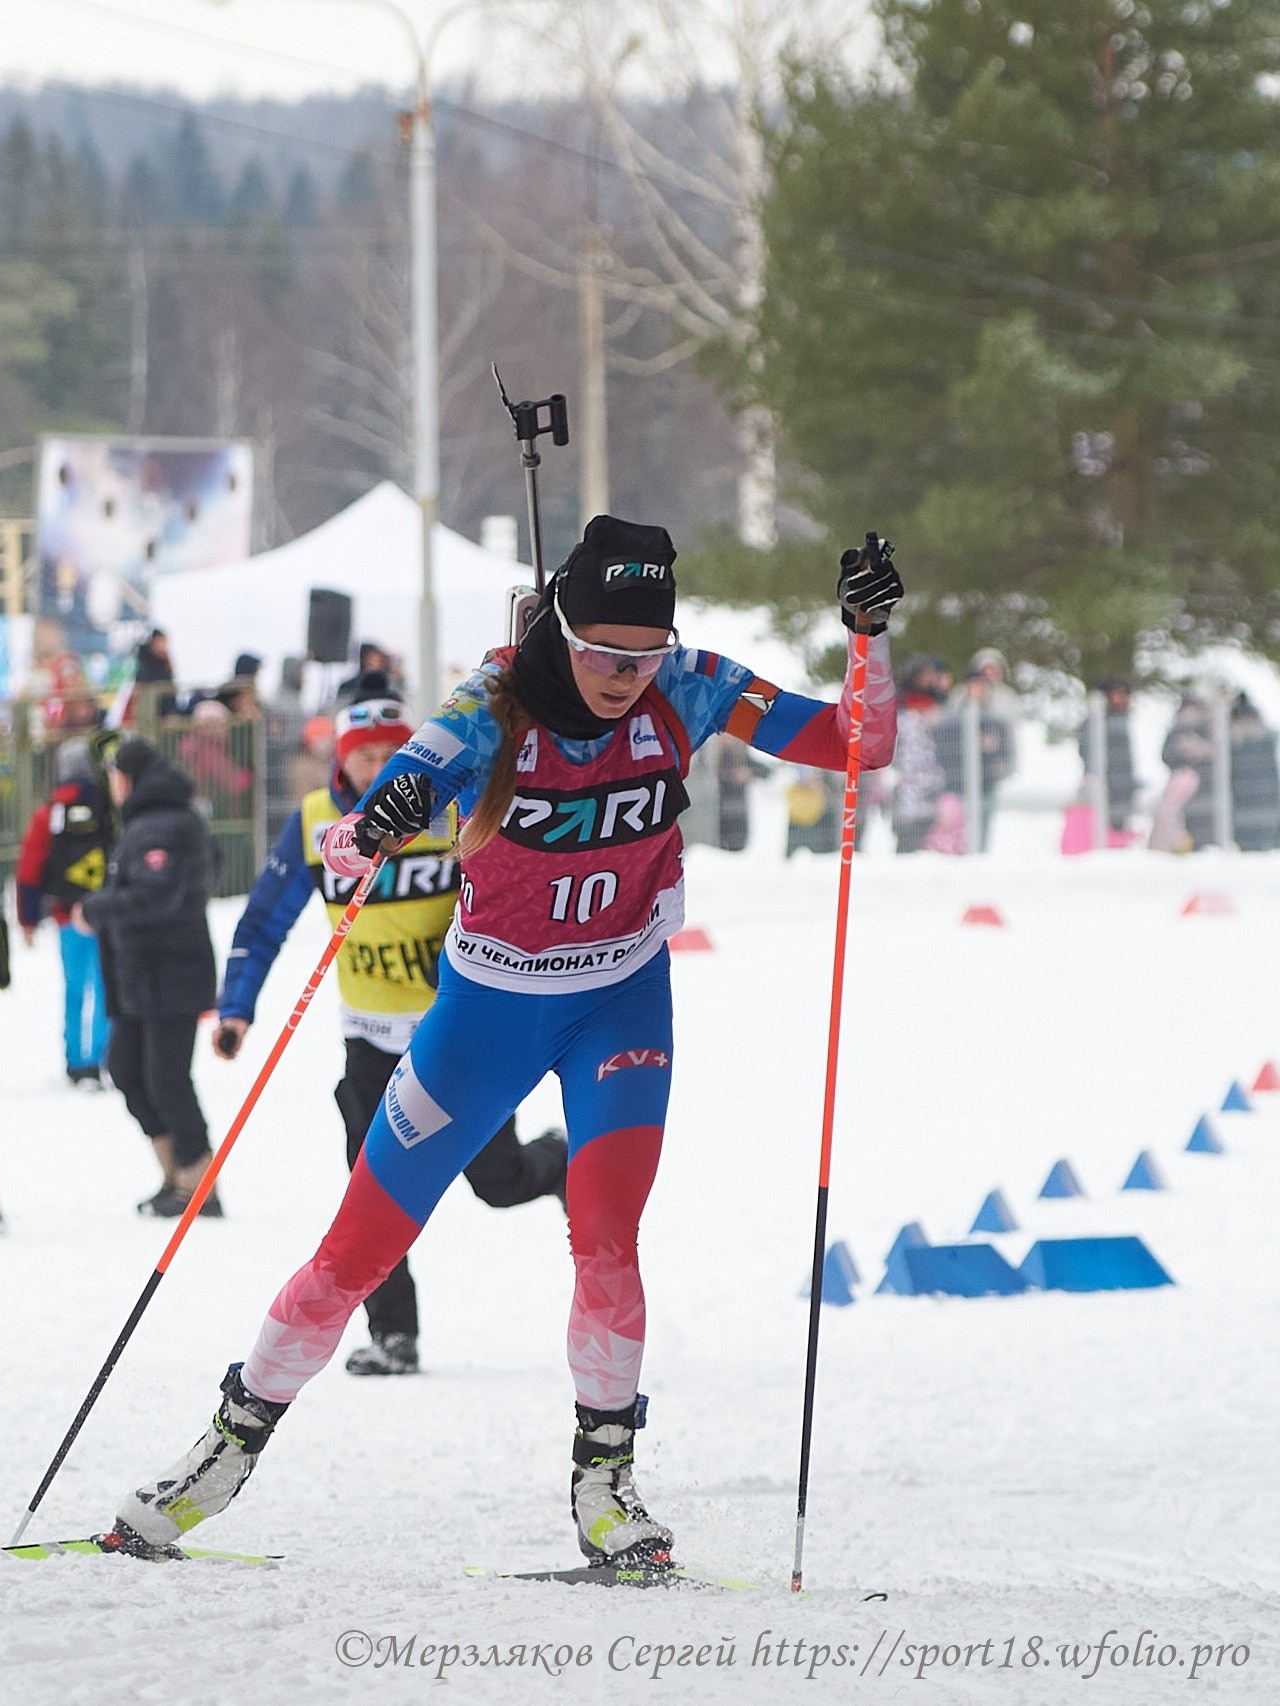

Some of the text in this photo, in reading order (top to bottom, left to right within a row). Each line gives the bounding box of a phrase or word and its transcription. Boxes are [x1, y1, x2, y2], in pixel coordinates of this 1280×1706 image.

[605, 562, 666, 582] PARI
[500, 779, 667, 844] PARI
[333, 829, 355, 849] KV
[549, 870, 618, 925] 10
[481, 948, 609, 973] ЧЕМПИОНАТ
[597, 1048, 668, 1082] KV+
